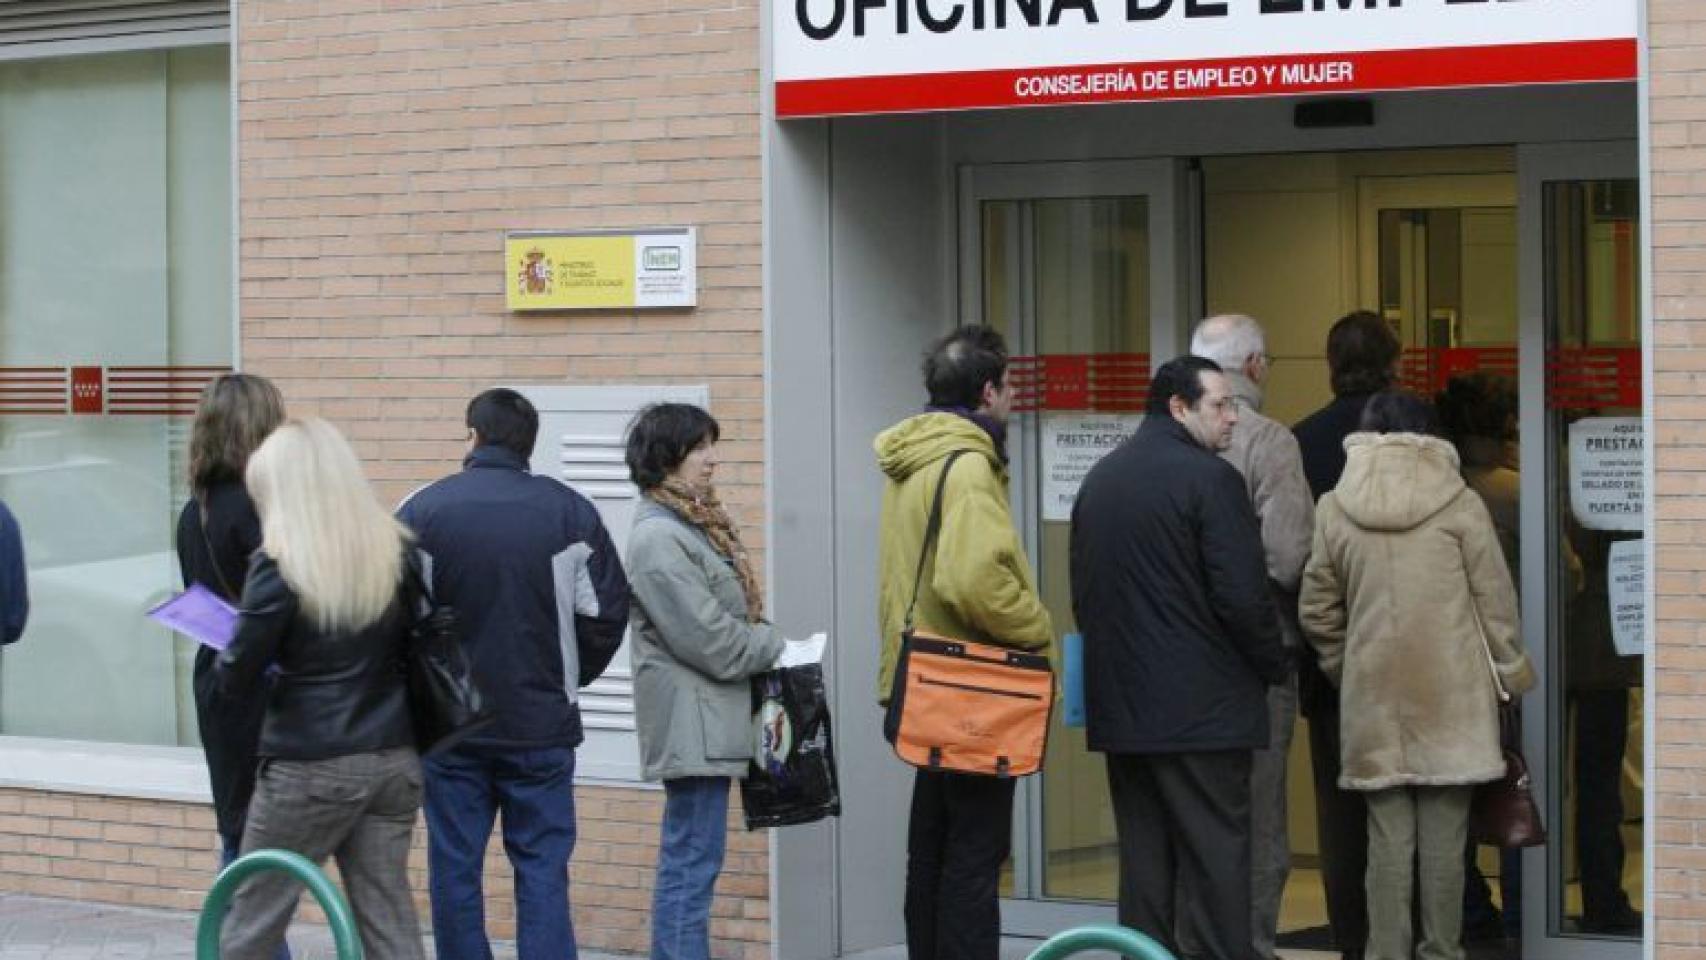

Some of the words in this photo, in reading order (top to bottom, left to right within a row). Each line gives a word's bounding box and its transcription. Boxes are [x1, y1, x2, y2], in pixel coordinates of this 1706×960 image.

[1015, 68, 1138, 96] CONSEJERÍA
[1142, 70, 1169, 91] DE
[1173, 66, 1257, 90] EMPLEO
[1261, 64, 1277, 85] Y
[1281, 61, 1354, 85] MUJER
